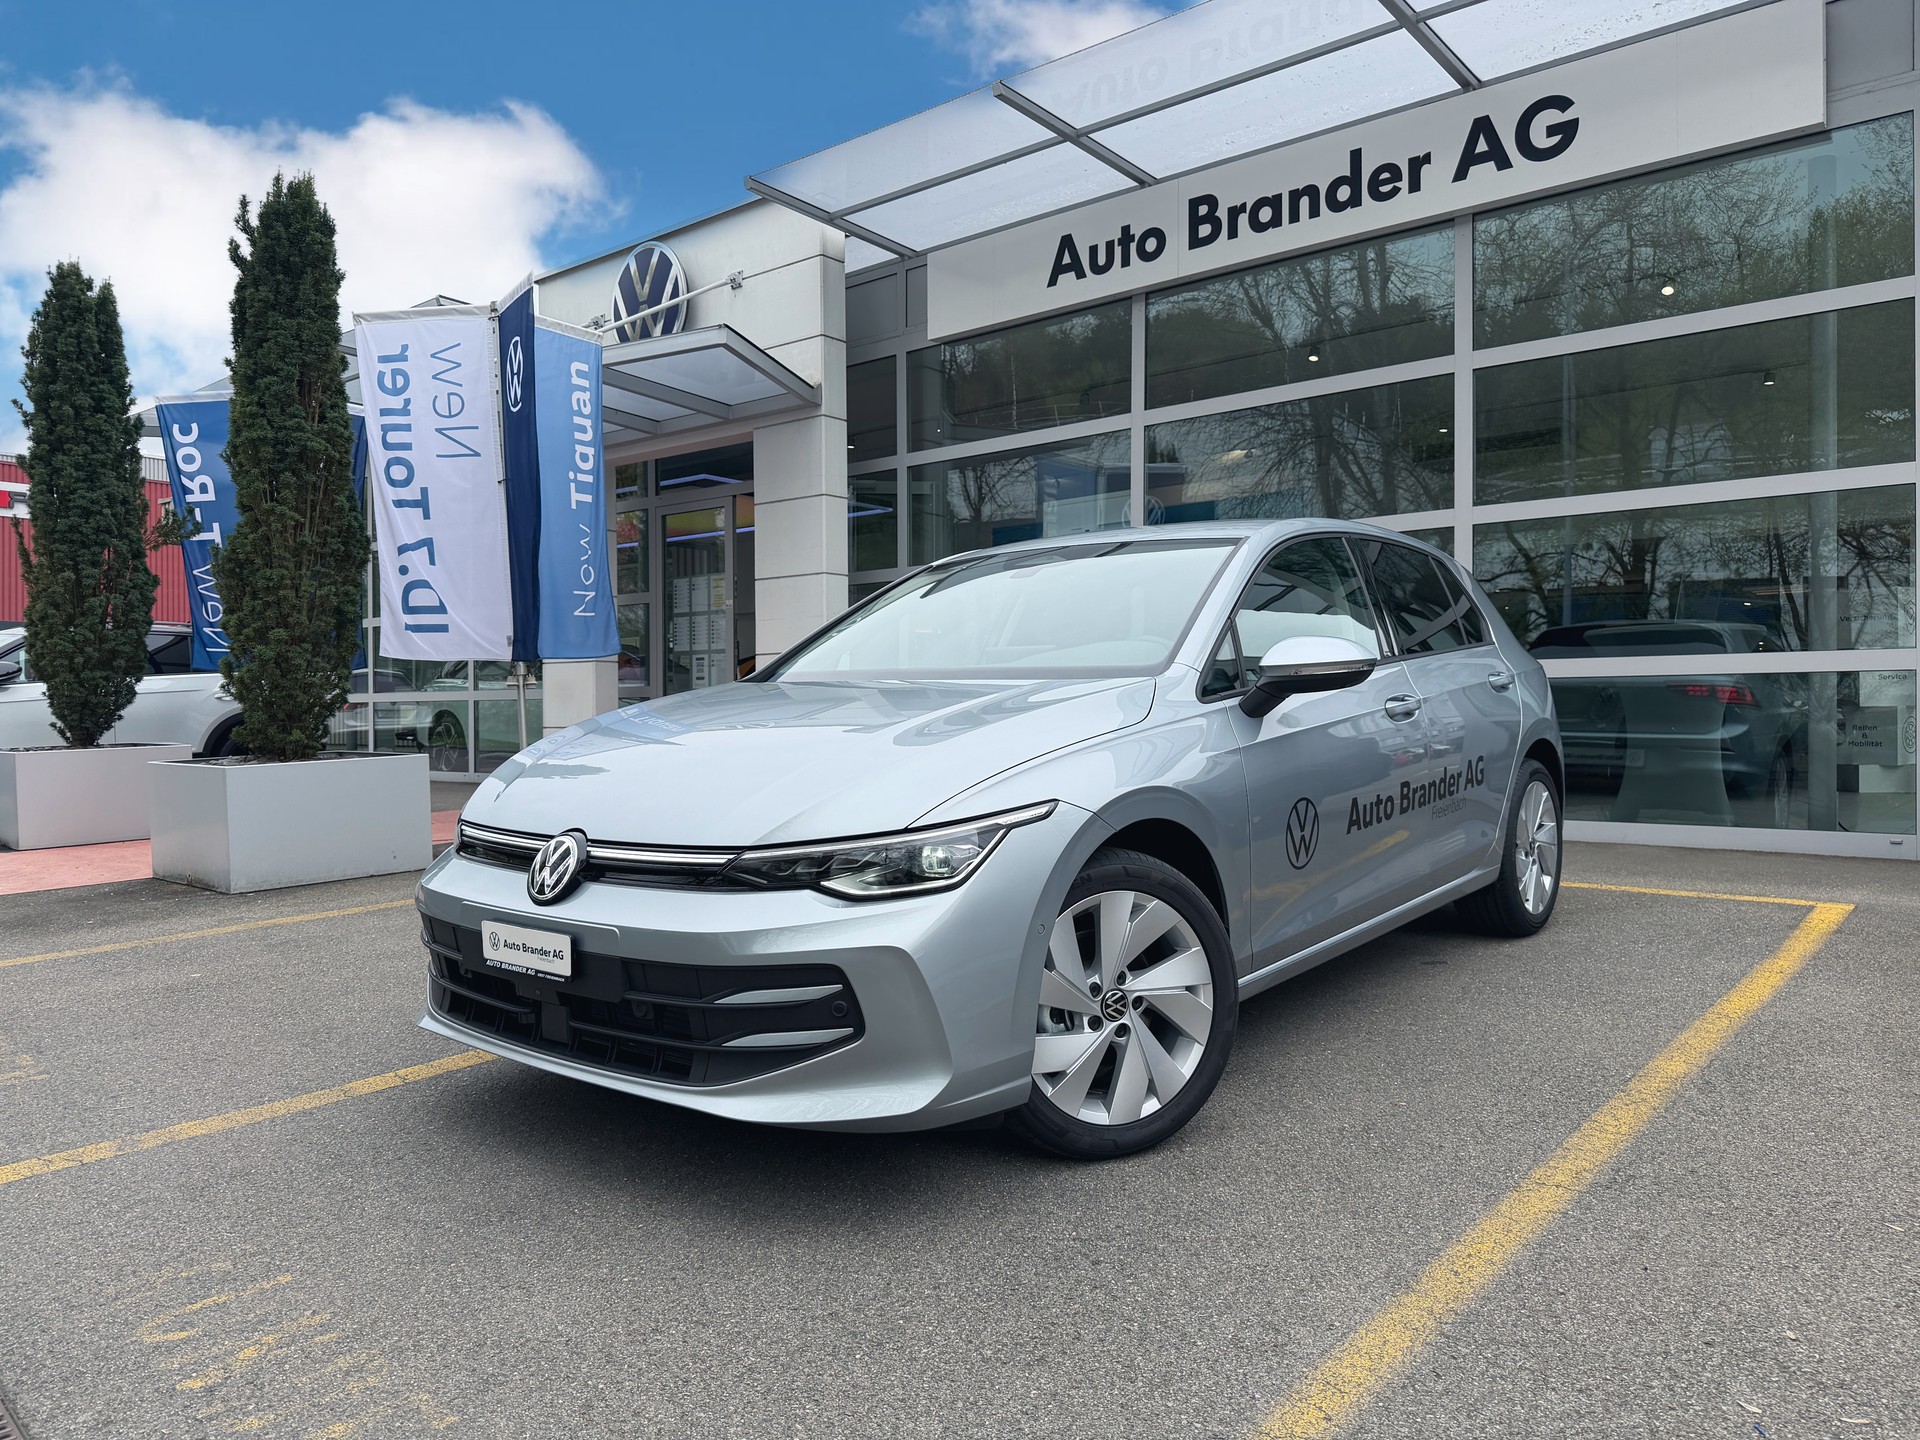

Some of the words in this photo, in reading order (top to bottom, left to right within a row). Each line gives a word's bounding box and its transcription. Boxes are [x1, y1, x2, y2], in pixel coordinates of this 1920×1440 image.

[1046, 223, 1167, 289] Auto
[1187, 147, 1433, 251] Brander
[1451, 94, 1580, 184] AG
[1346, 793, 1395, 835] Auto
[1400, 767, 1463, 816] Brander
[1464, 755, 1485, 792] AG
[1431, 797, 1467, 821] Freienbach
[503, 939, 521, 952] Auto
[522, 942, 551, 958] Brander
[552, 949, 565, 960] AG
[486, 959, 501, 968] AUTO
[501, 962, 527, 973] BRANDER
[527, 968, 536, 976] AG
